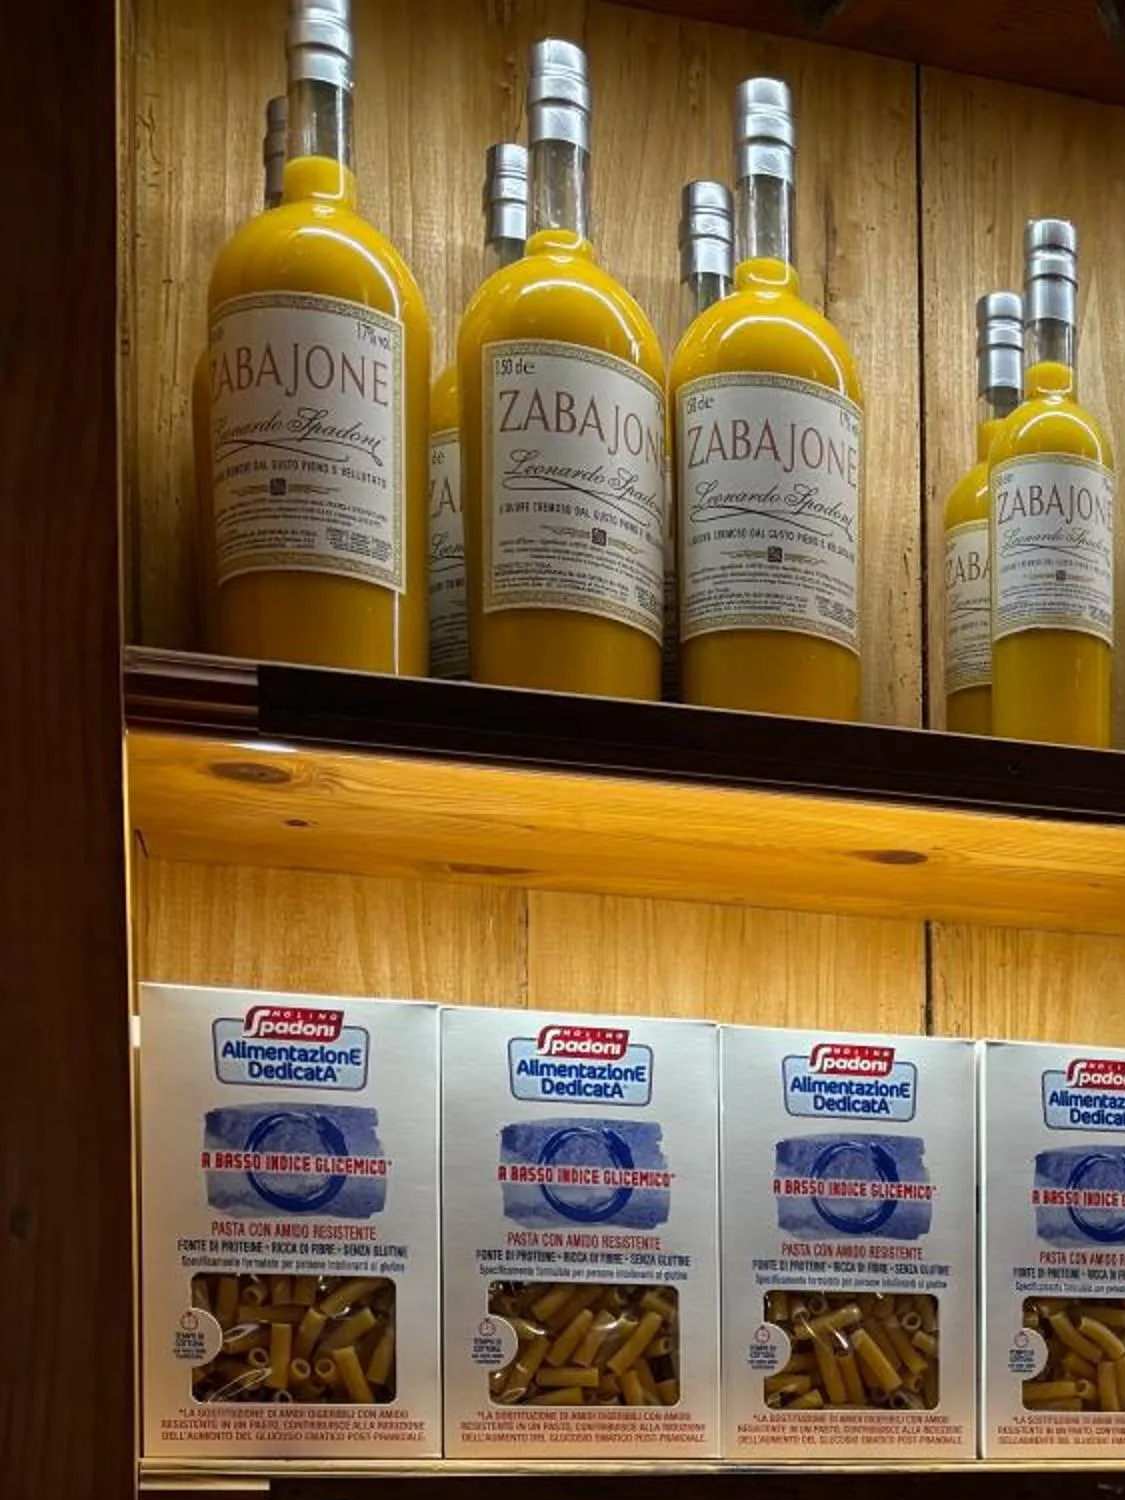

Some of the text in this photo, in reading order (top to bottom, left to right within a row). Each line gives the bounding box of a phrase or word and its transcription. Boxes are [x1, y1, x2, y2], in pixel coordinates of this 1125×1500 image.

[243, 1009, 336, 1039] Spadoni
[536, 1029, 622, 1057] Spadoni
[808, 1047, 888, 1073] Spadoni
[215, 1152, 311, 1172] BASSO INDICE
[511, 1166, 600, 1185] BASSO INDICE
[784, 1180, 867, 1198] BASSO INDICE
